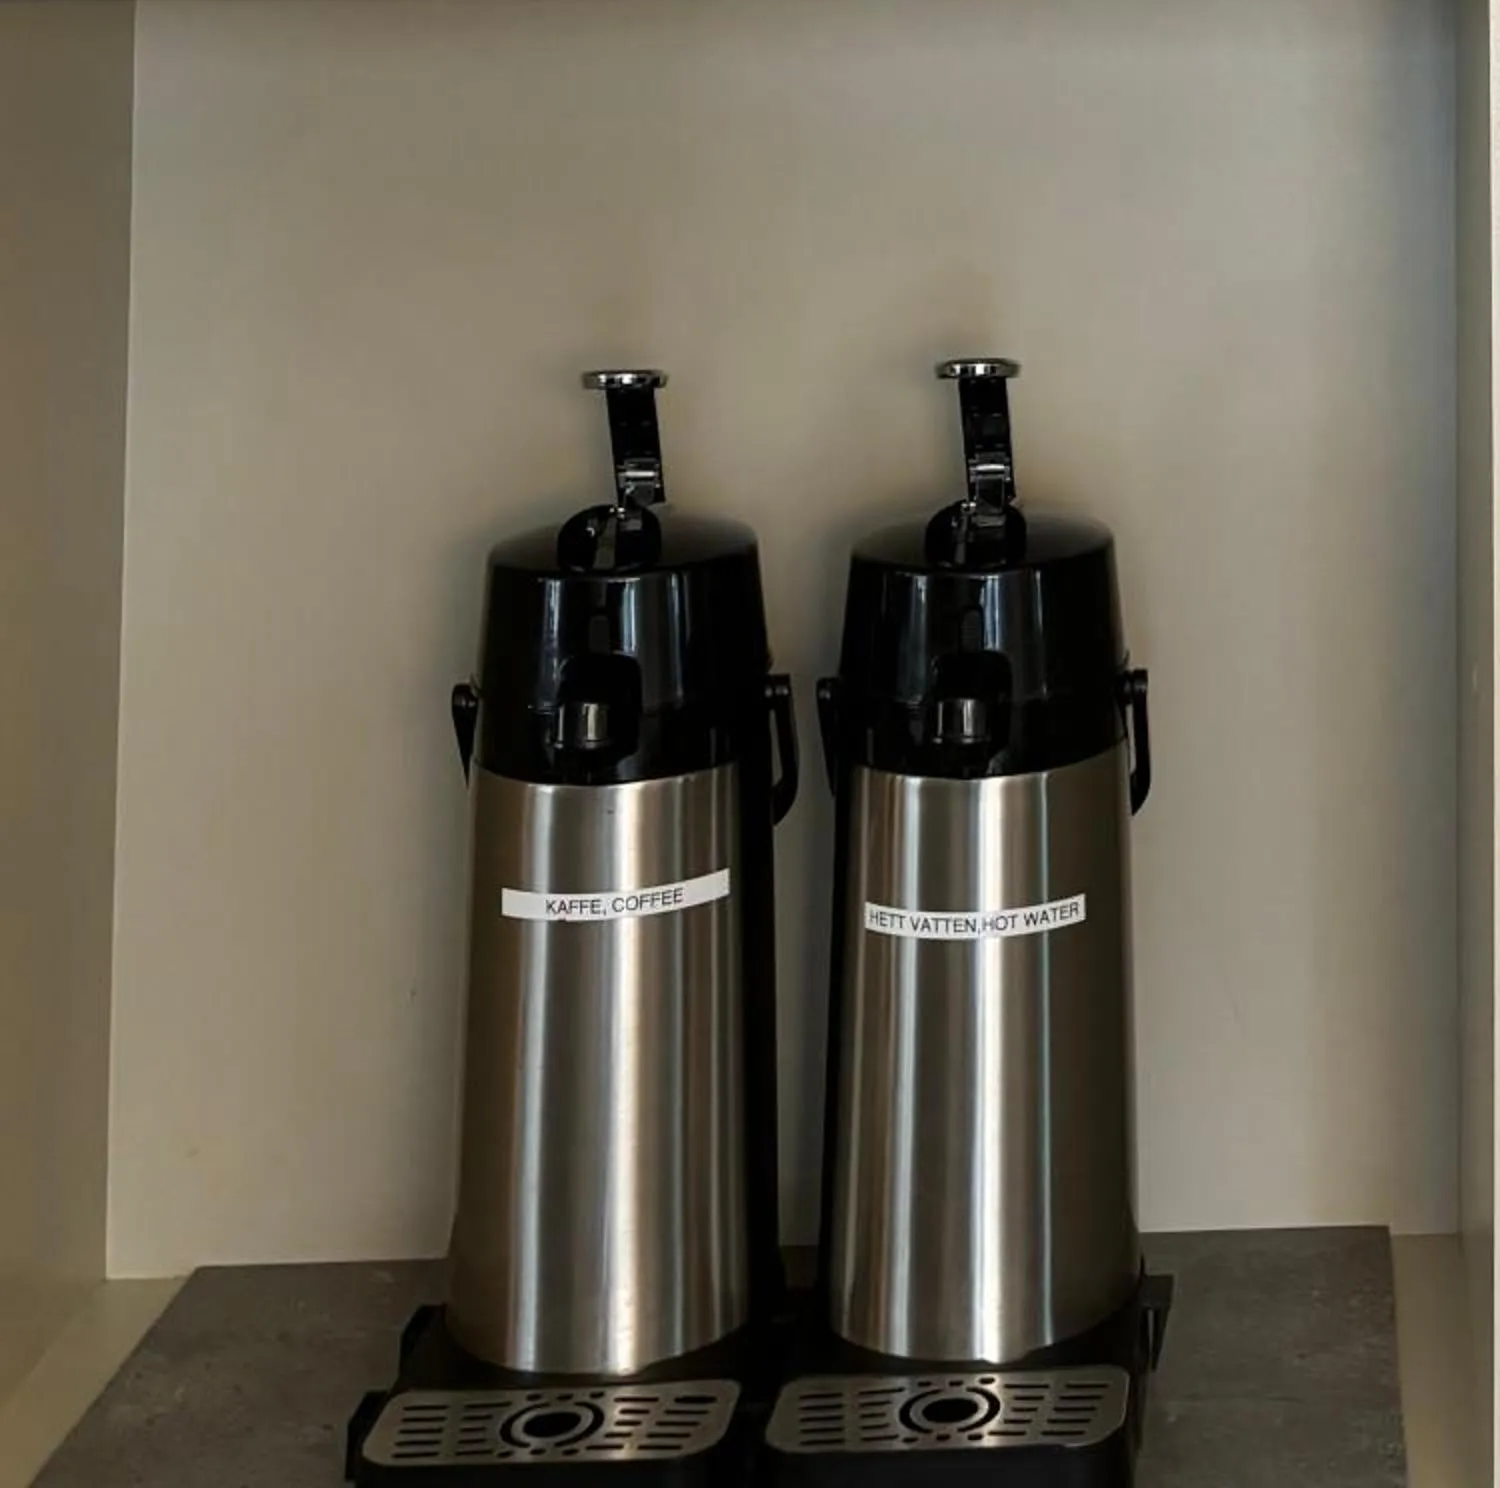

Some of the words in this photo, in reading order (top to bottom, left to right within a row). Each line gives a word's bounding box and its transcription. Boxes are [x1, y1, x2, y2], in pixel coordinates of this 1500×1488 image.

[545, 898, 607, 916] KAFFE,
[611, 888, 684, 913] COFFEE
[869, 911, 906, 927] HETT
[1023, 901, 1080, 927] WATER
